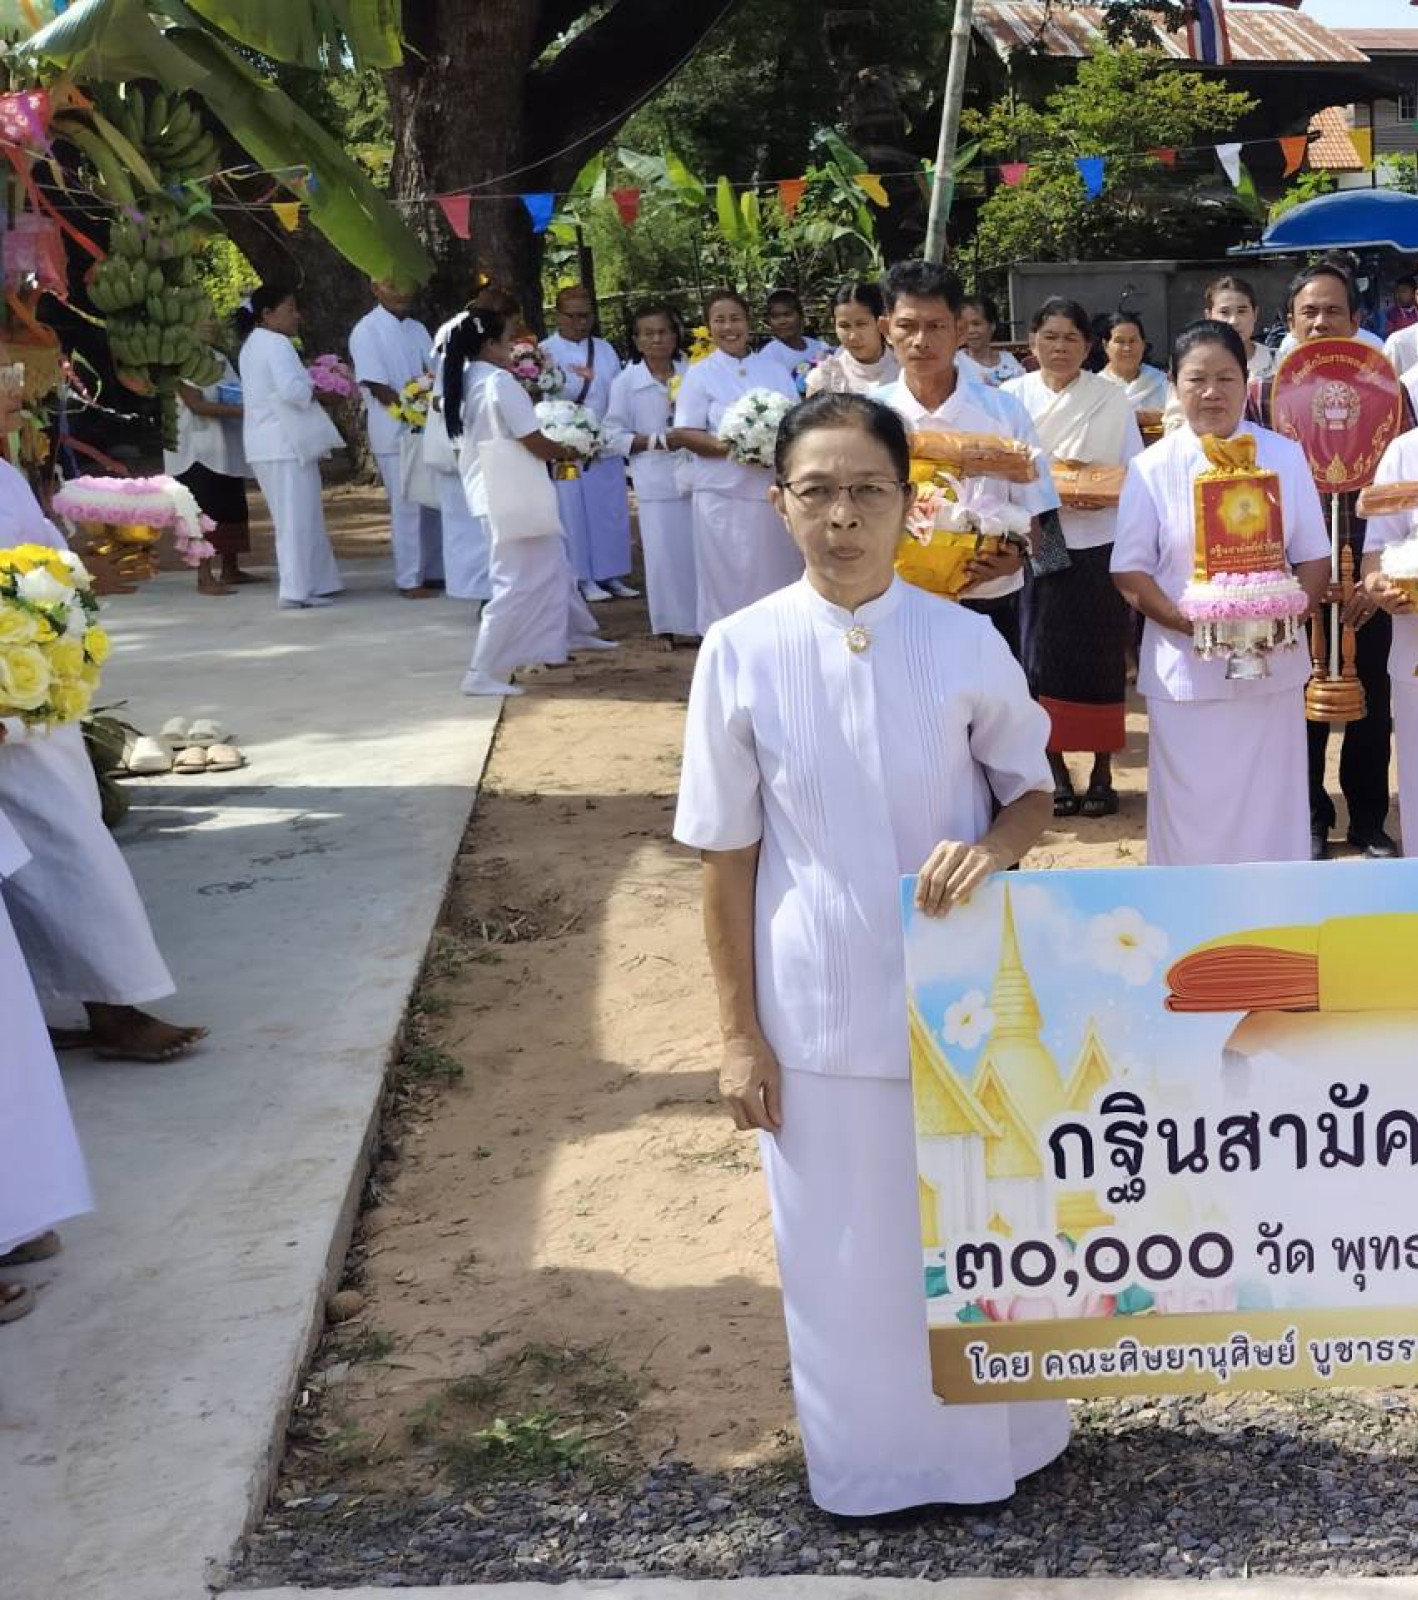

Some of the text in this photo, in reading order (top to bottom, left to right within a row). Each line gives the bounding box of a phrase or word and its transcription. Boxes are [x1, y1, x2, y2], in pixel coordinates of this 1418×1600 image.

[955, 1231, 1234, 1297] ๓๐,๐๐๐
[1256, 1221, 1315, 1275] วัด
[970, 1346, 1030, 1379] โดย
[1045, 1329, 1297, 1379] คณะศิษยานุศิษย์
